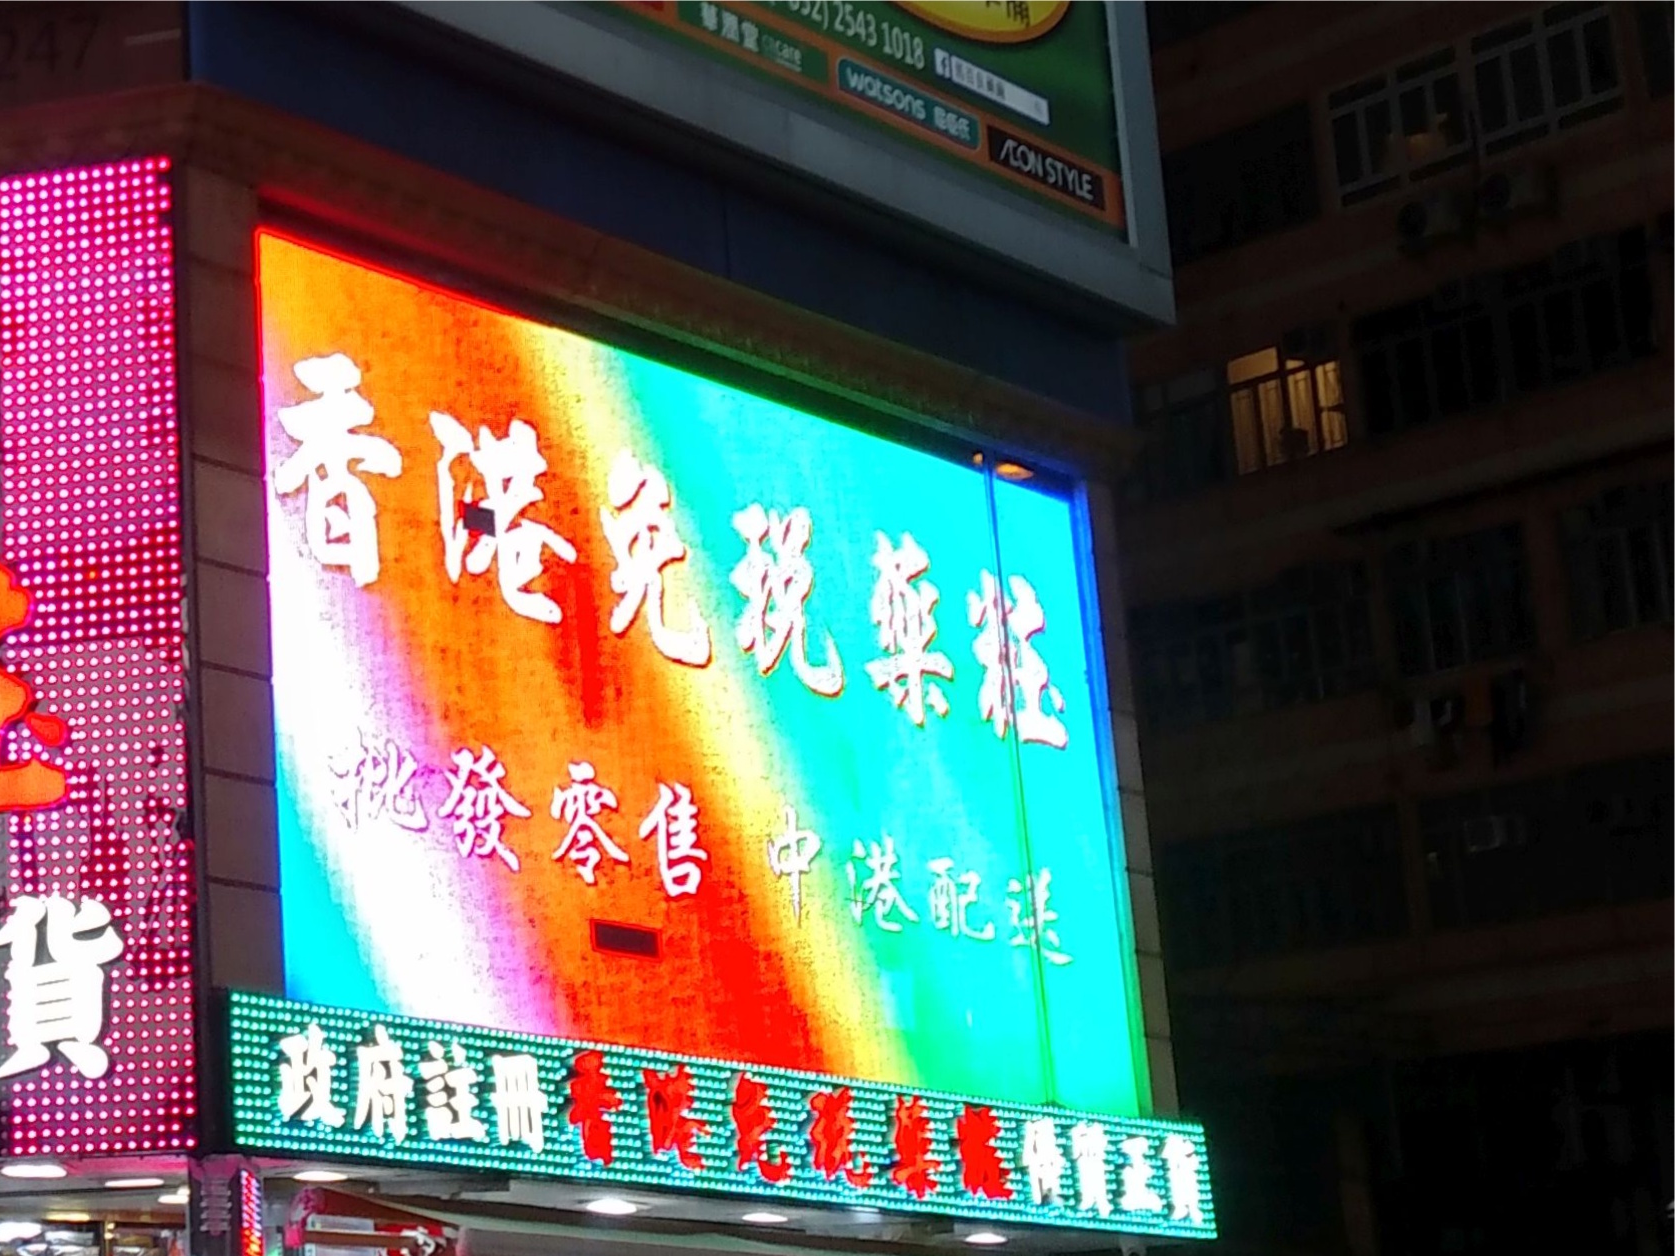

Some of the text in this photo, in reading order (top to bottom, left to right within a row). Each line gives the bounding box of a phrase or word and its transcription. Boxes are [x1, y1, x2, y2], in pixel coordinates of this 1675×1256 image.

[833, 0, 877, 47] 2543
[881, 22, 925, 70] 1018
[845, 67, 927, 121] watsons
[1045, 158, 1094, 201] STYLE
[330, 744, 708, 897] 批發零售
[767, 805, 1074, 965] 中港配送
[277, 1024, 550, 1155] 政府註冊
